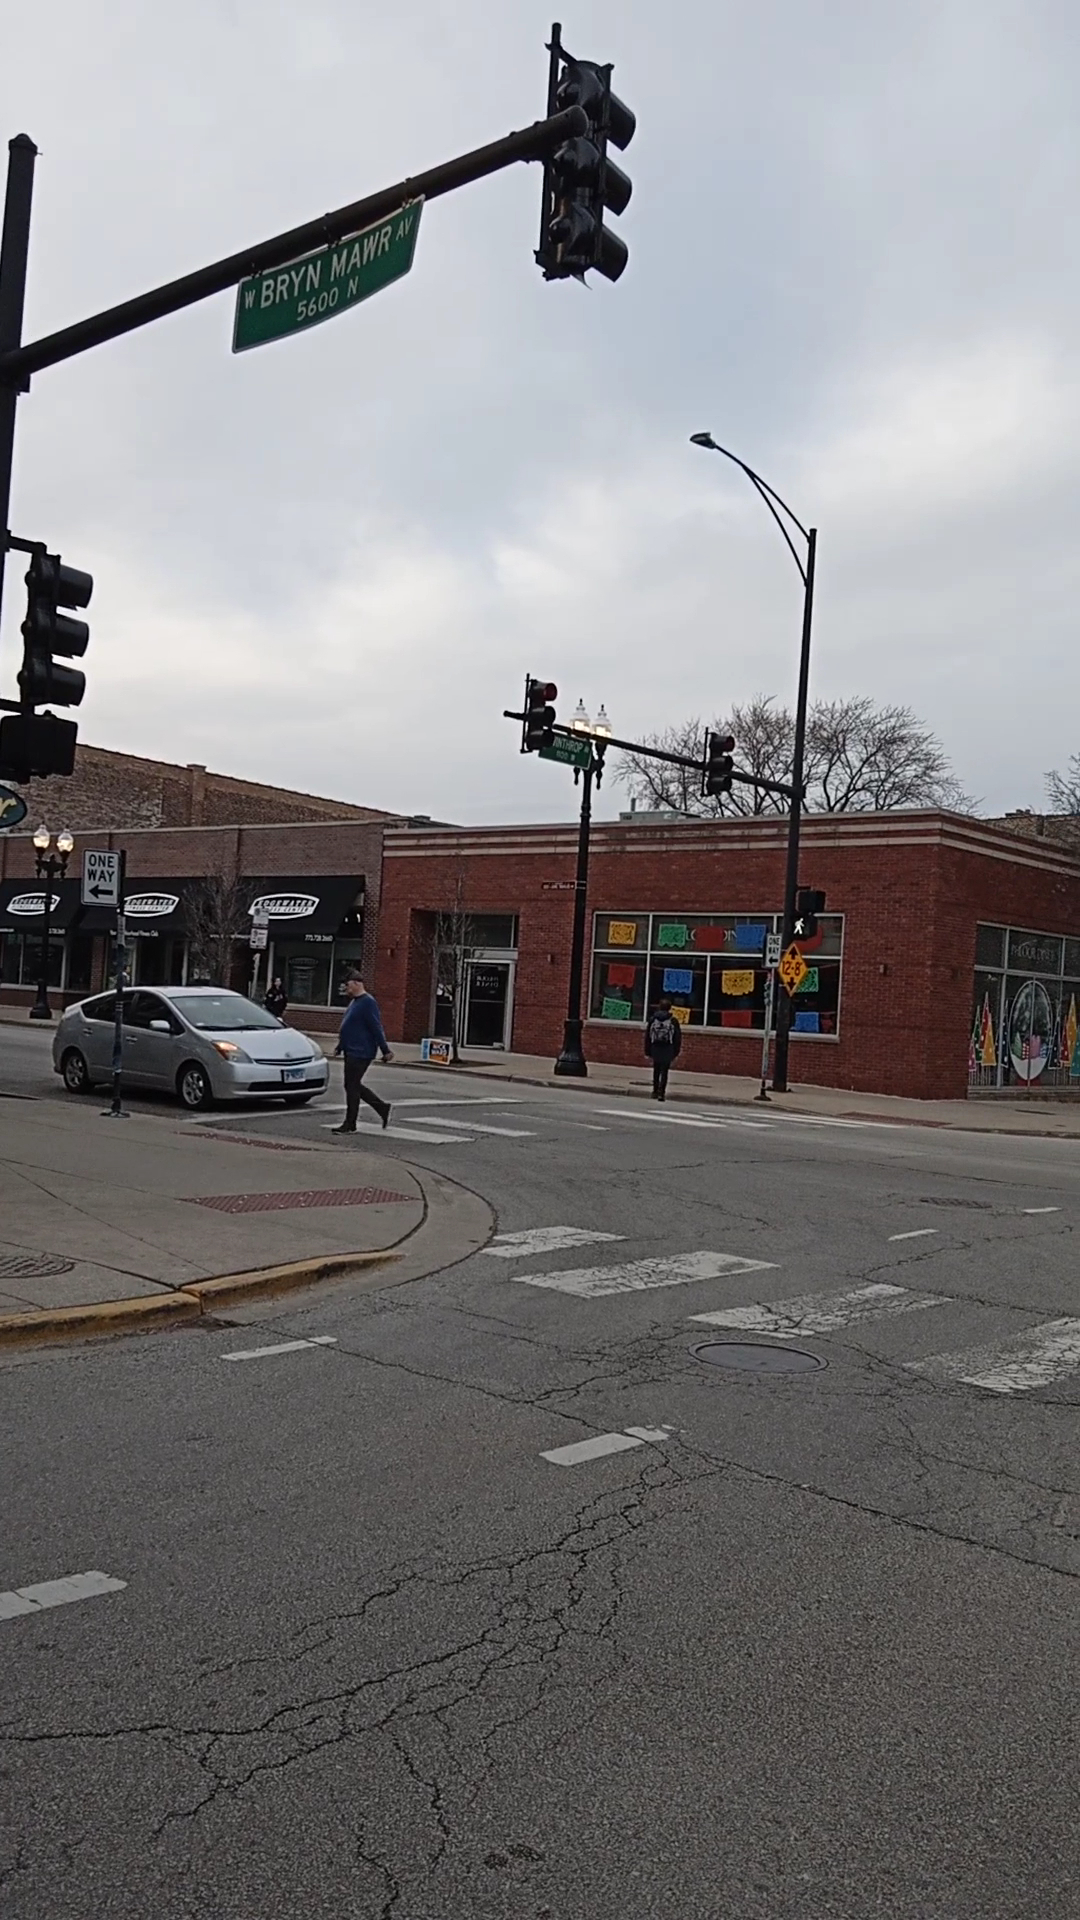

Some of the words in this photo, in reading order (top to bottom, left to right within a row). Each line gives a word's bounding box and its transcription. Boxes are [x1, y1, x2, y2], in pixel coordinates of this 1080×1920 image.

[244, 289, 256, 309] W
[260, 260, 321, 309] BRYN
[330, 225, 392, 282] MAWR
[396, 215, 414, 241] AV
[296, 287, 340, 321] 5600
[347, 275, 359, 298] N
[88, 854, 115, 868] ONE
[87, 868, 115, 883] WAY
[257, 899, 314, 907] EDGEWATER
[769, 937, 780, 946] ONE
